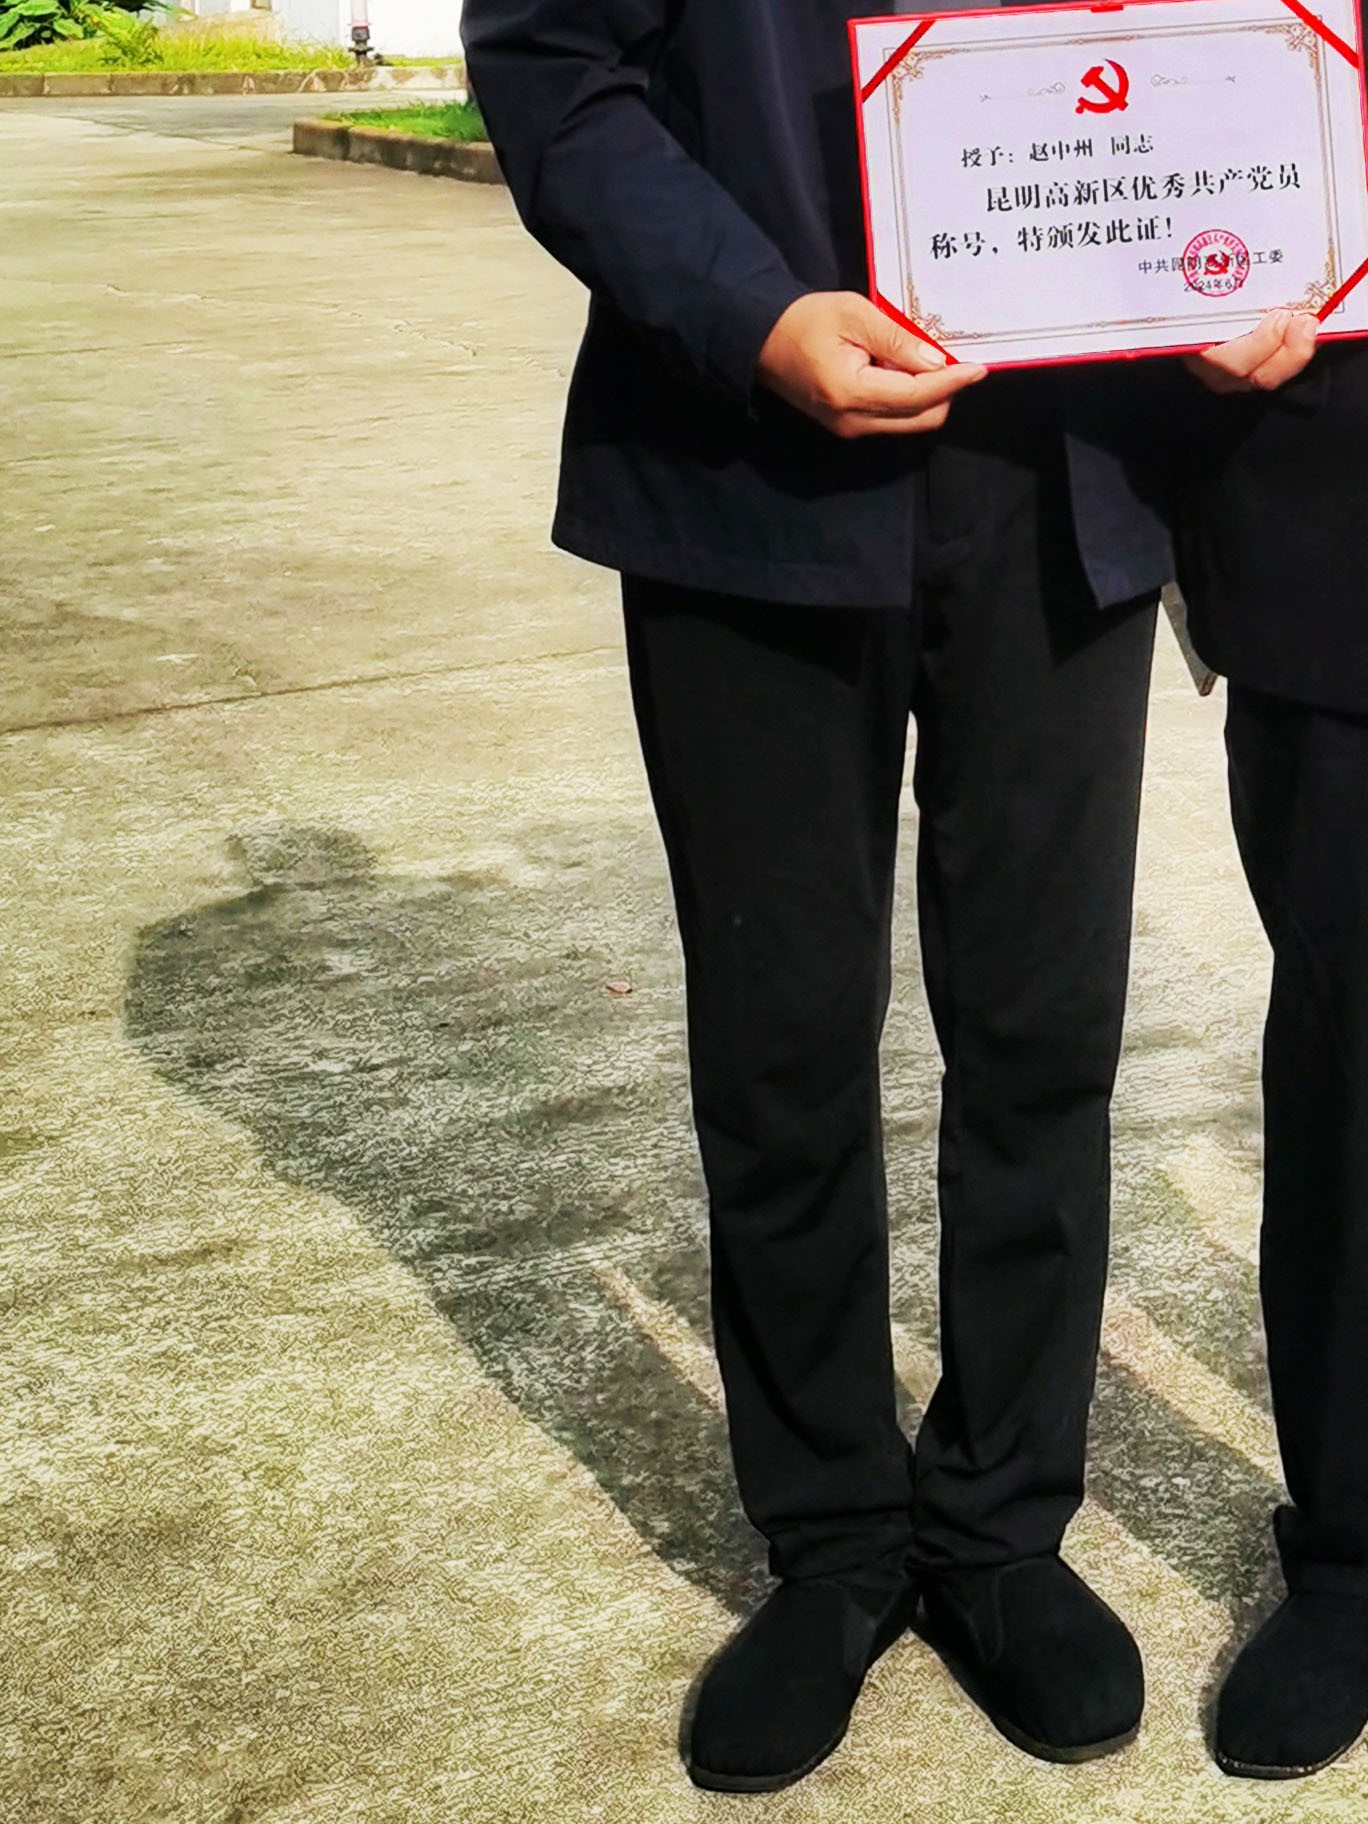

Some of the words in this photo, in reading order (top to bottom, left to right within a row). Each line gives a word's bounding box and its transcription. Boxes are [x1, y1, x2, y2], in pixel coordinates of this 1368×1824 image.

[1110, 133, 1155, 157] 同志
[986, 163, 1301, 213] 昆明高新区优秀共产党员
